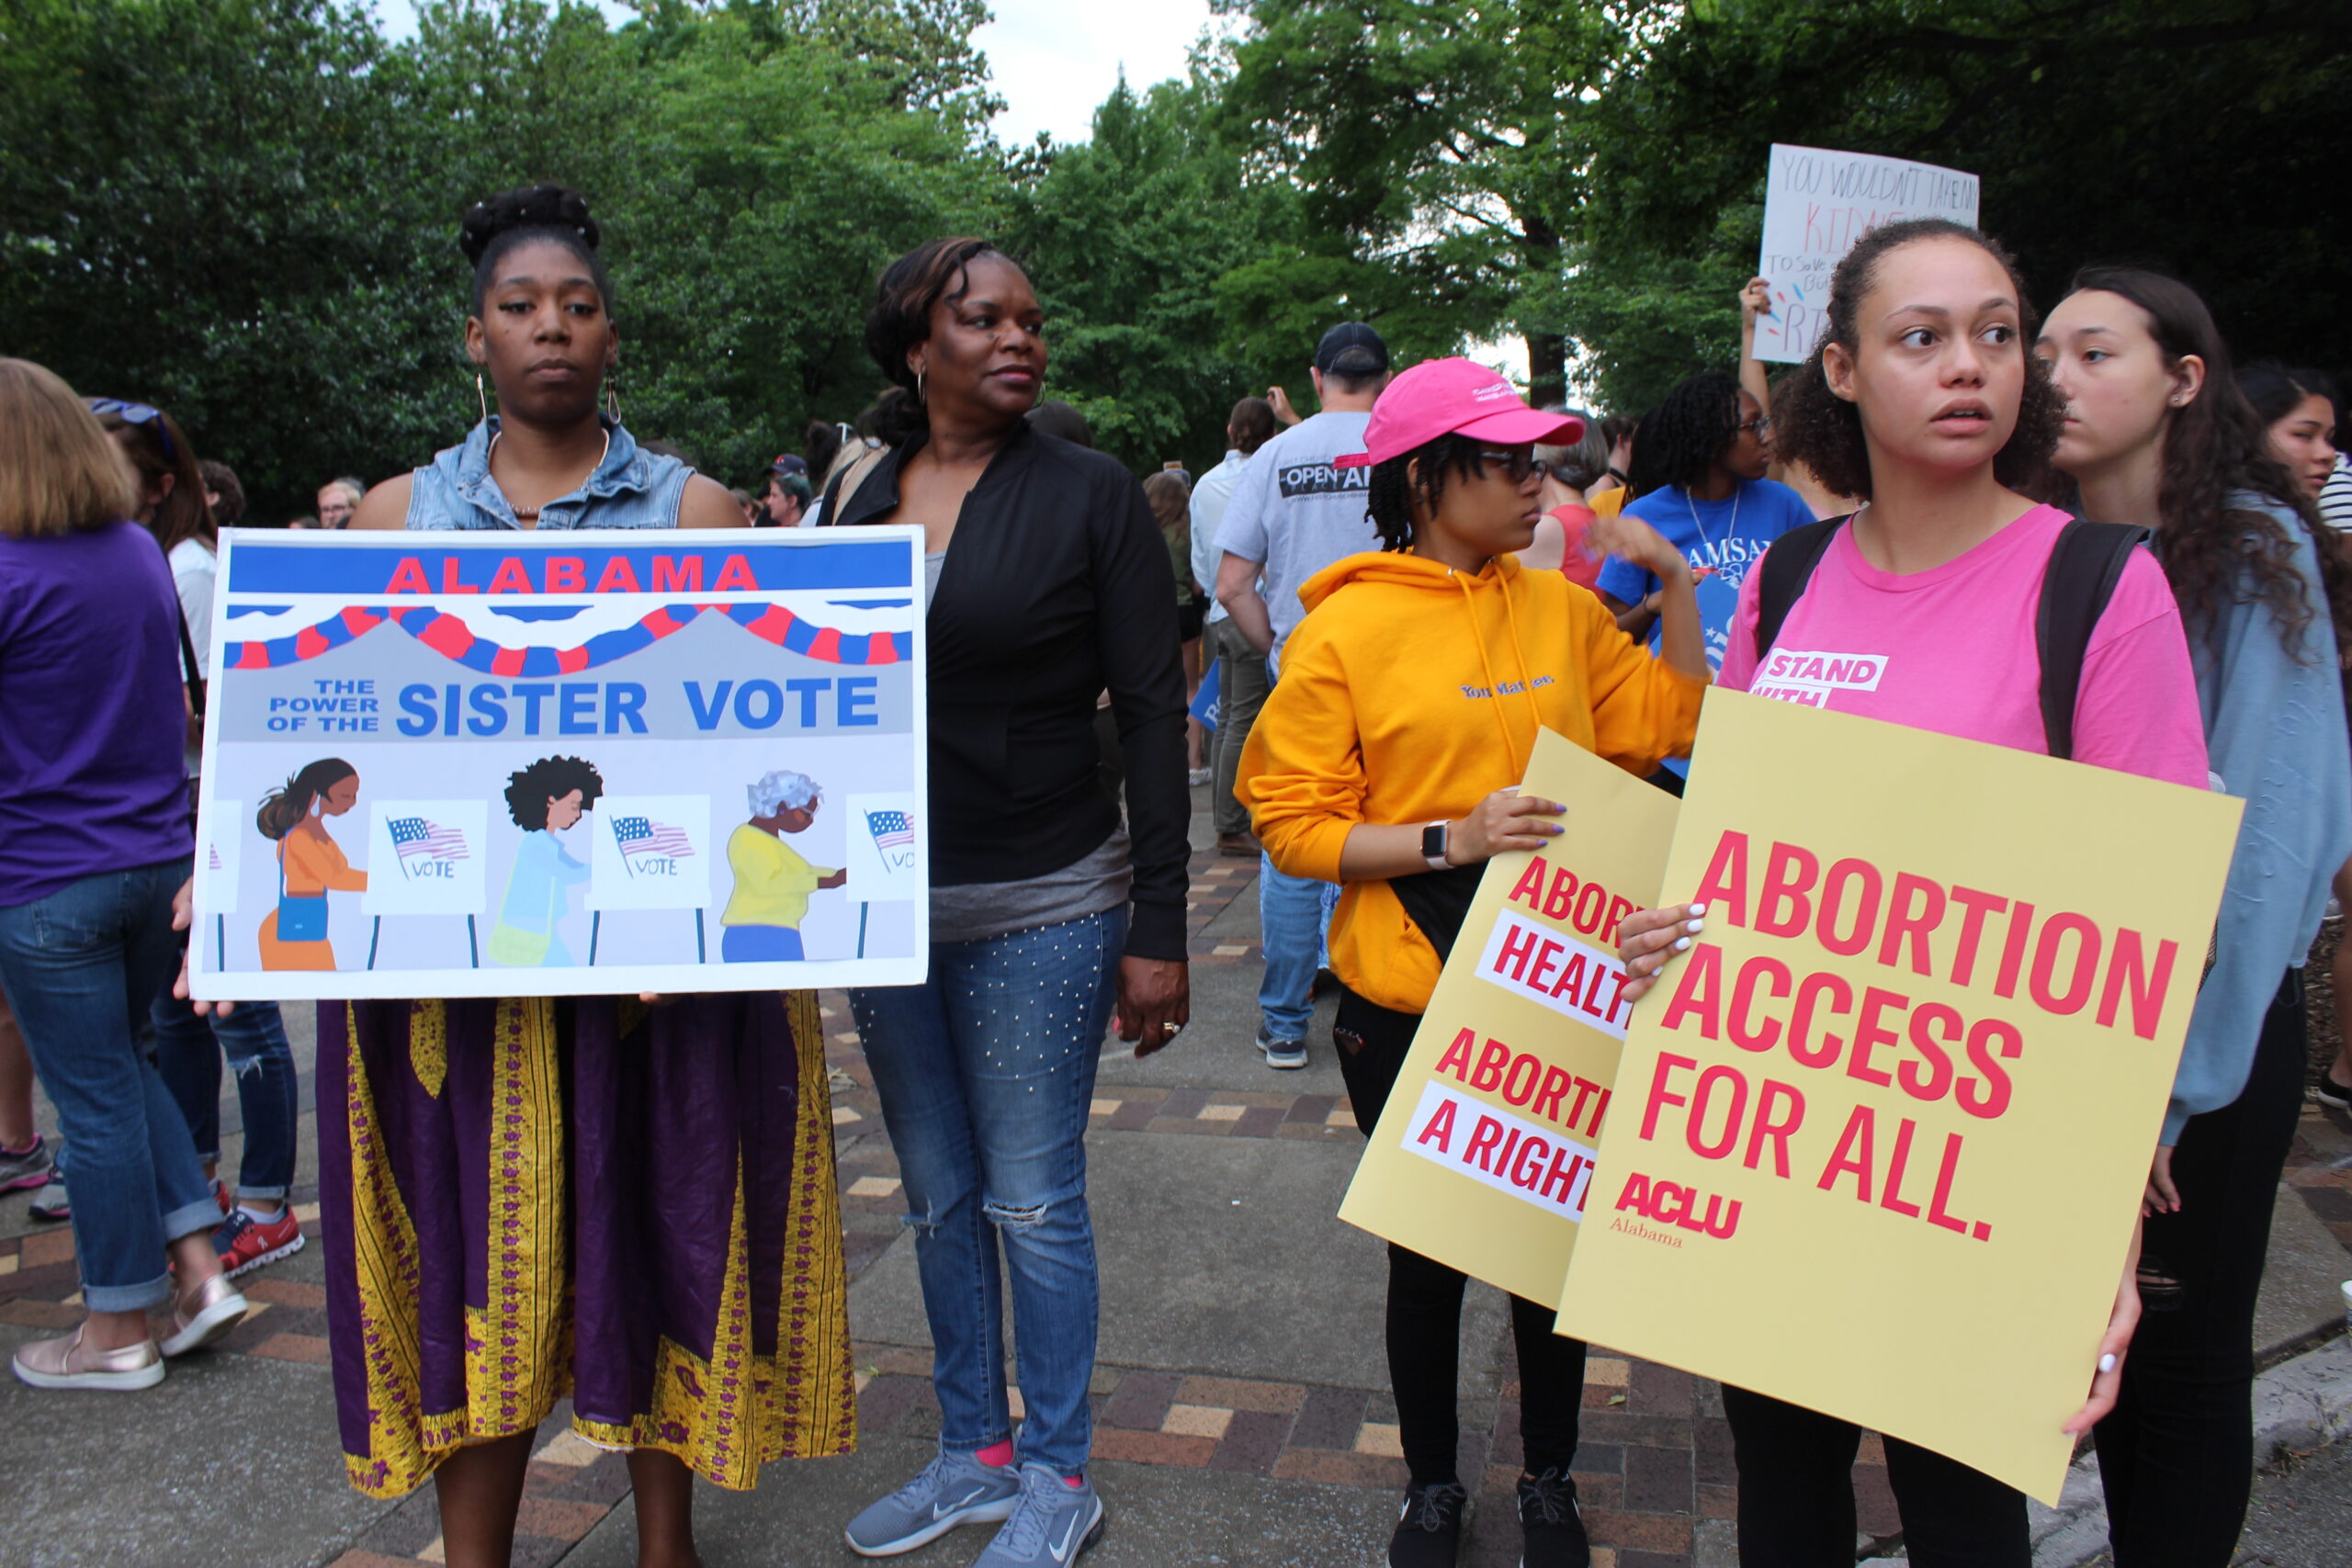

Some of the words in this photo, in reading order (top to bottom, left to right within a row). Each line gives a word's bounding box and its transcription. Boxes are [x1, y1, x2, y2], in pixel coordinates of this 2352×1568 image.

[1782, 155, 1823, 193] YOU
[1286, 465, 1338, 486] OPEN
[386, 555, 761, 595] ALABAMA
[314, 679, 375, 694] THE
[1768, 655, 1878, 684] STAND
[269, 697, 379, 713] POWER
[396, 682, 649, 738] SISTER
[683, 676, 878, 731] VOTE
[1460, 684, 1493, 699] You
[266, 716, 308, 732] OF
[317, 716, 379, 732] THE
[412, 860, 456, 878] VOTE
[635, 858, 678, 875] VOTE
[1508, 855, 1645, 950] ABOR
[1692, 829, 2178, 1041] ABORTION
[1493, 924, 1635, 1031] HEALT
[1660, 942, 2023, 1120] ACCESS
[1418, 1100, 1458, 1154] A
[1639, 1051, 1805, 1179] FOR
[1816, 1104, 1992, 1243] ALL.
[1614, 1172, 1744, 1240] ACLU
[1610, 1217, 1683, 1249] Alabama
